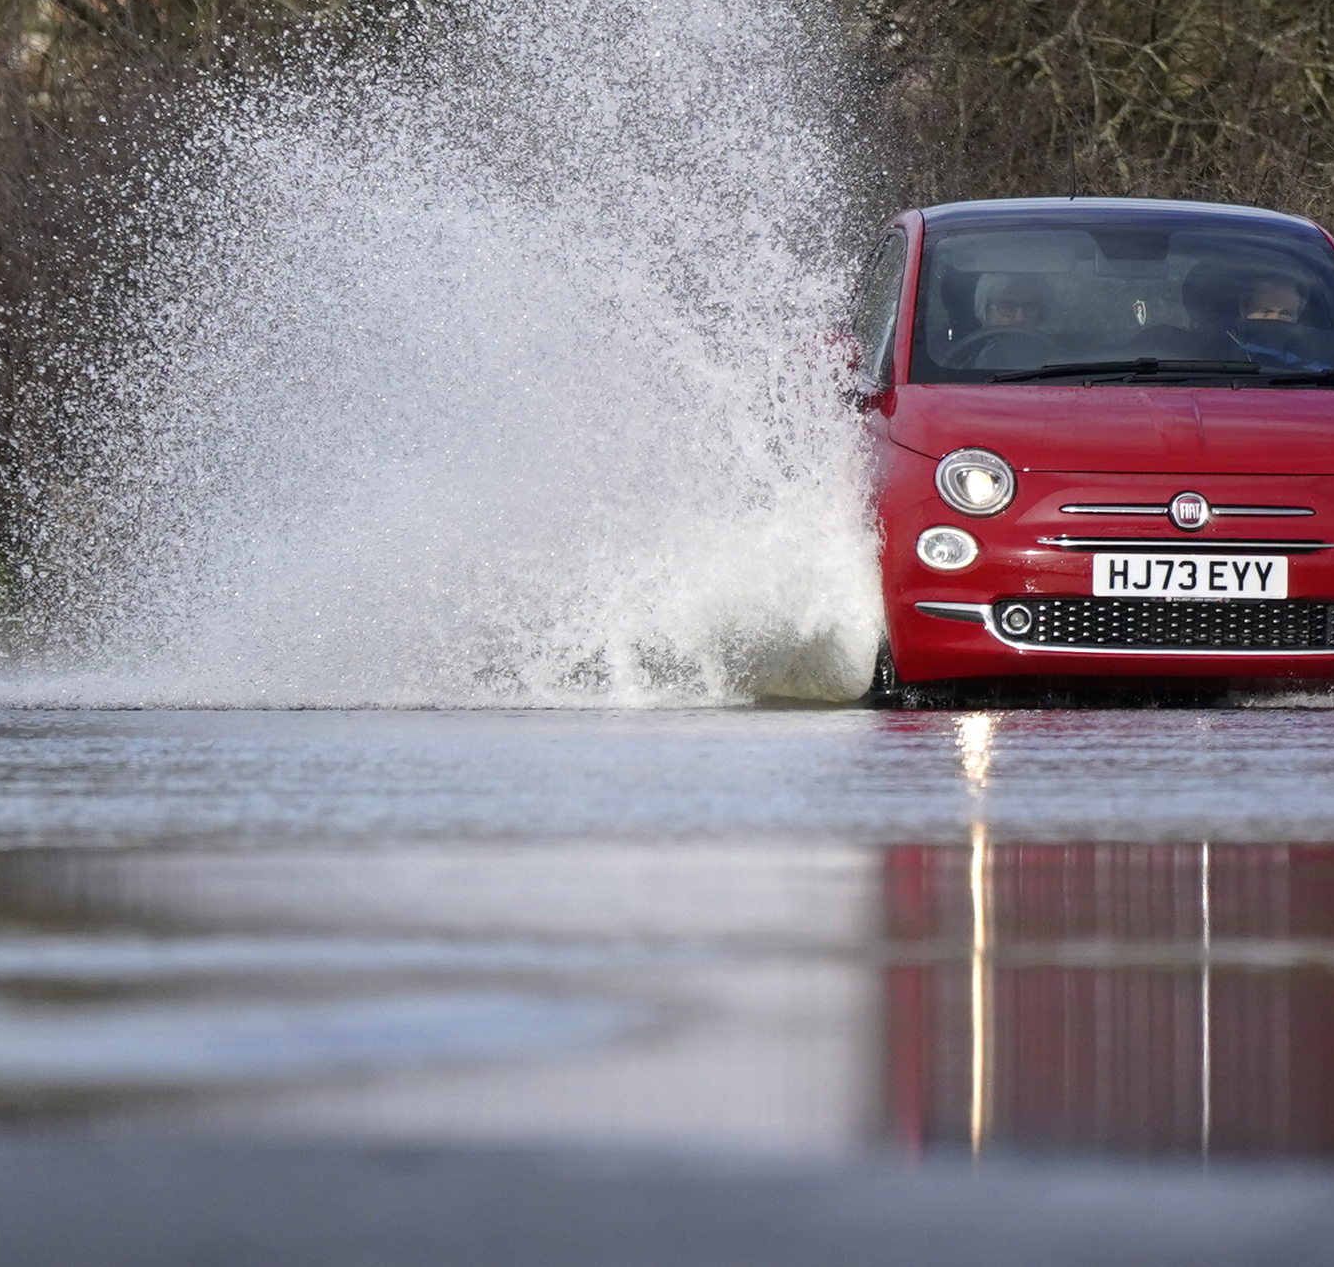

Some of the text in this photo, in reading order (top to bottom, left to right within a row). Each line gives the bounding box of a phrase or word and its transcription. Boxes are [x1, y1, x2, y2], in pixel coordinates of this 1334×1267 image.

[1179, 502, 1201, 519] FIAT
[1109, 559, 1273, 591] HJ73 EYY
